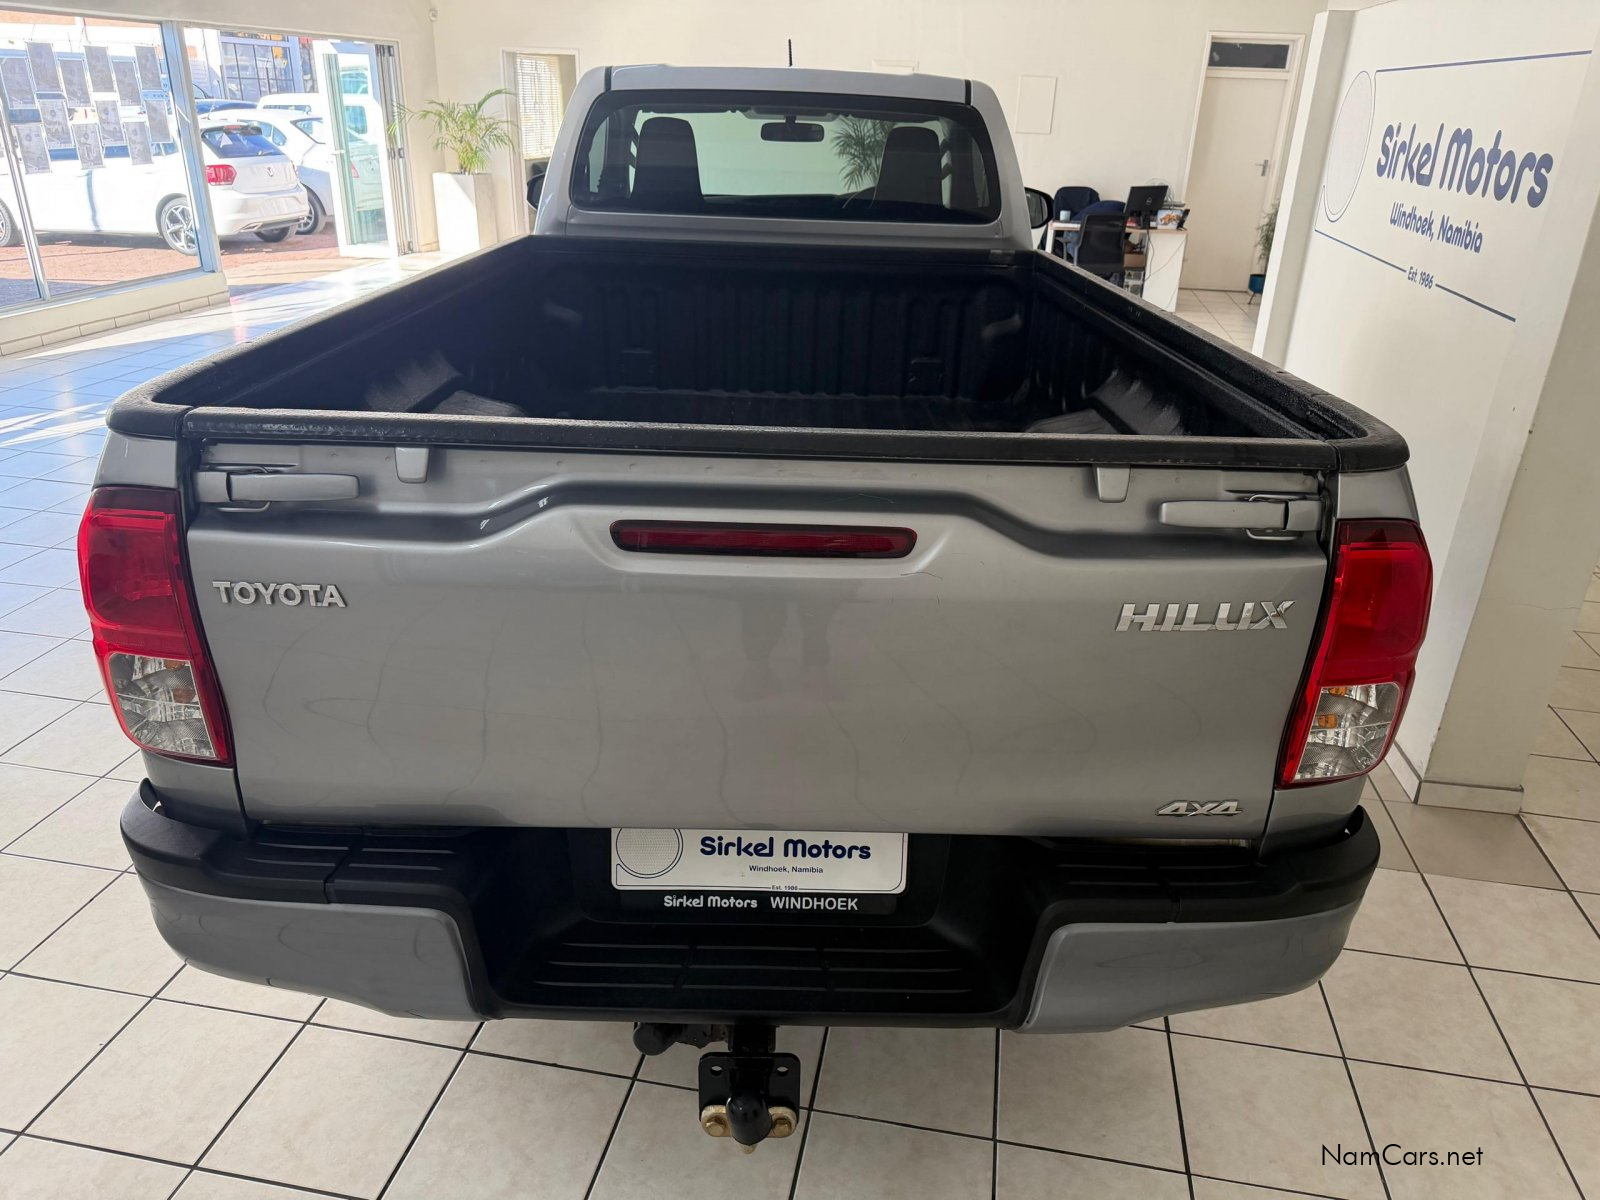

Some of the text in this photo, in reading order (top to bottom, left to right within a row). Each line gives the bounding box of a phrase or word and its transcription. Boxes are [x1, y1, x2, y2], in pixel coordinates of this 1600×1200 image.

[1376, 121, 1554, 209] Sirkel Motors
[1389, 201, 1483, 254] Windhoek, Namibia
[1418, 270, 1434, 290] 1986
[212, 581, 347, 608] TOYOTA
[1115, 600, 1295, 632] HILUX
[700, 836, 871, 860] Sirkel Motors
[748, 864, 824, 874] Windhoek, Namibia
[663, 895, 858, 911] Sirkel Motors WINDHOEK
